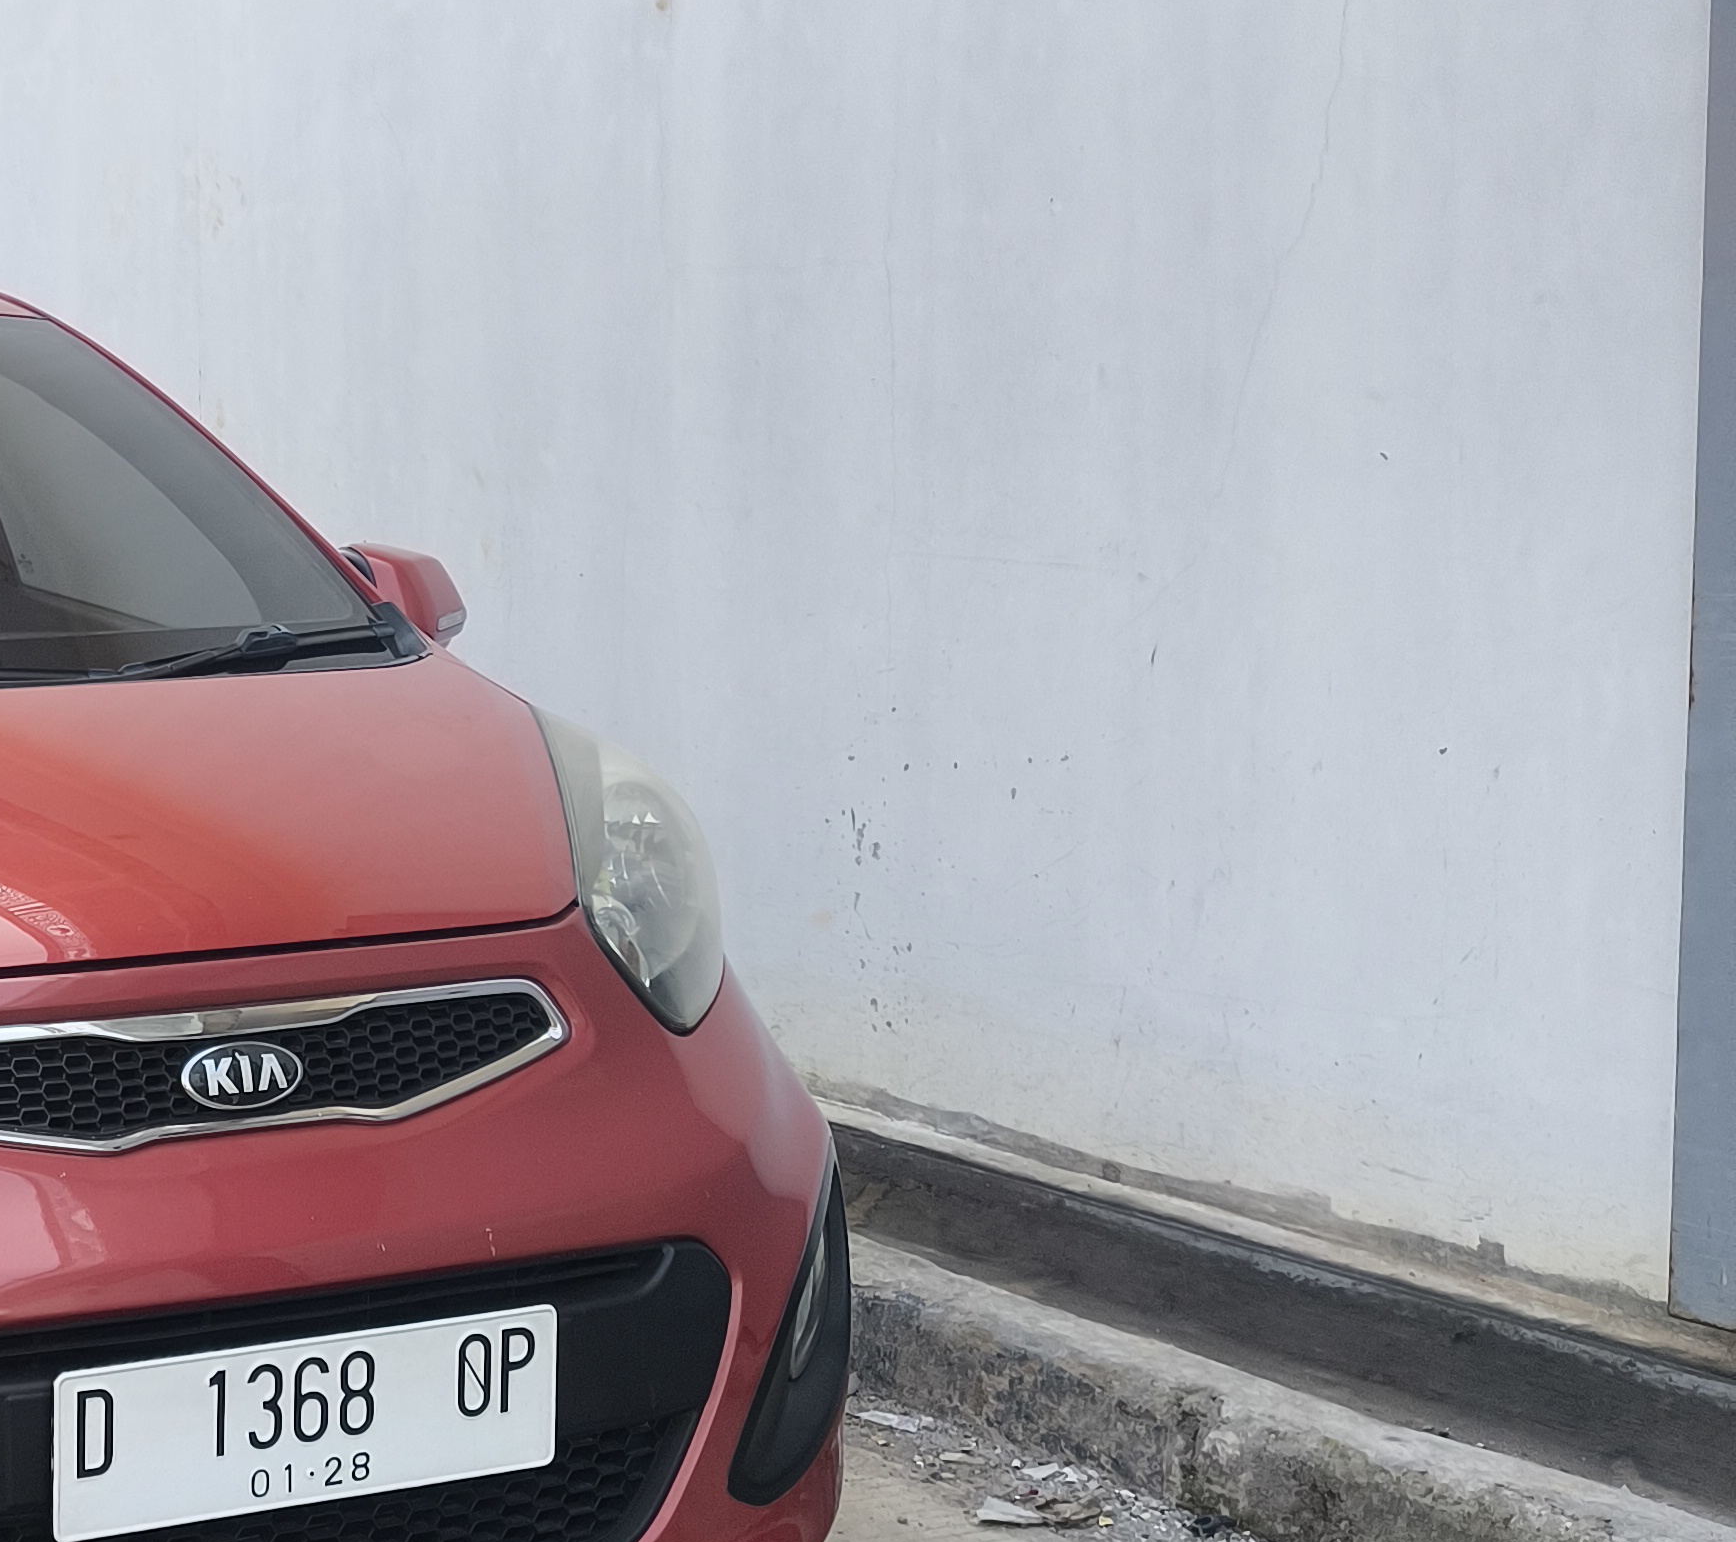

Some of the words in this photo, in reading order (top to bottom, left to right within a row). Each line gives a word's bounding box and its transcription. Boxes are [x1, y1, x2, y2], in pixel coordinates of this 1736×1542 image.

[202, 1051, 288, 1097] KIA
[76, 1388, 114, 1480] D
[208, 1350, 376, 1458] 1368
